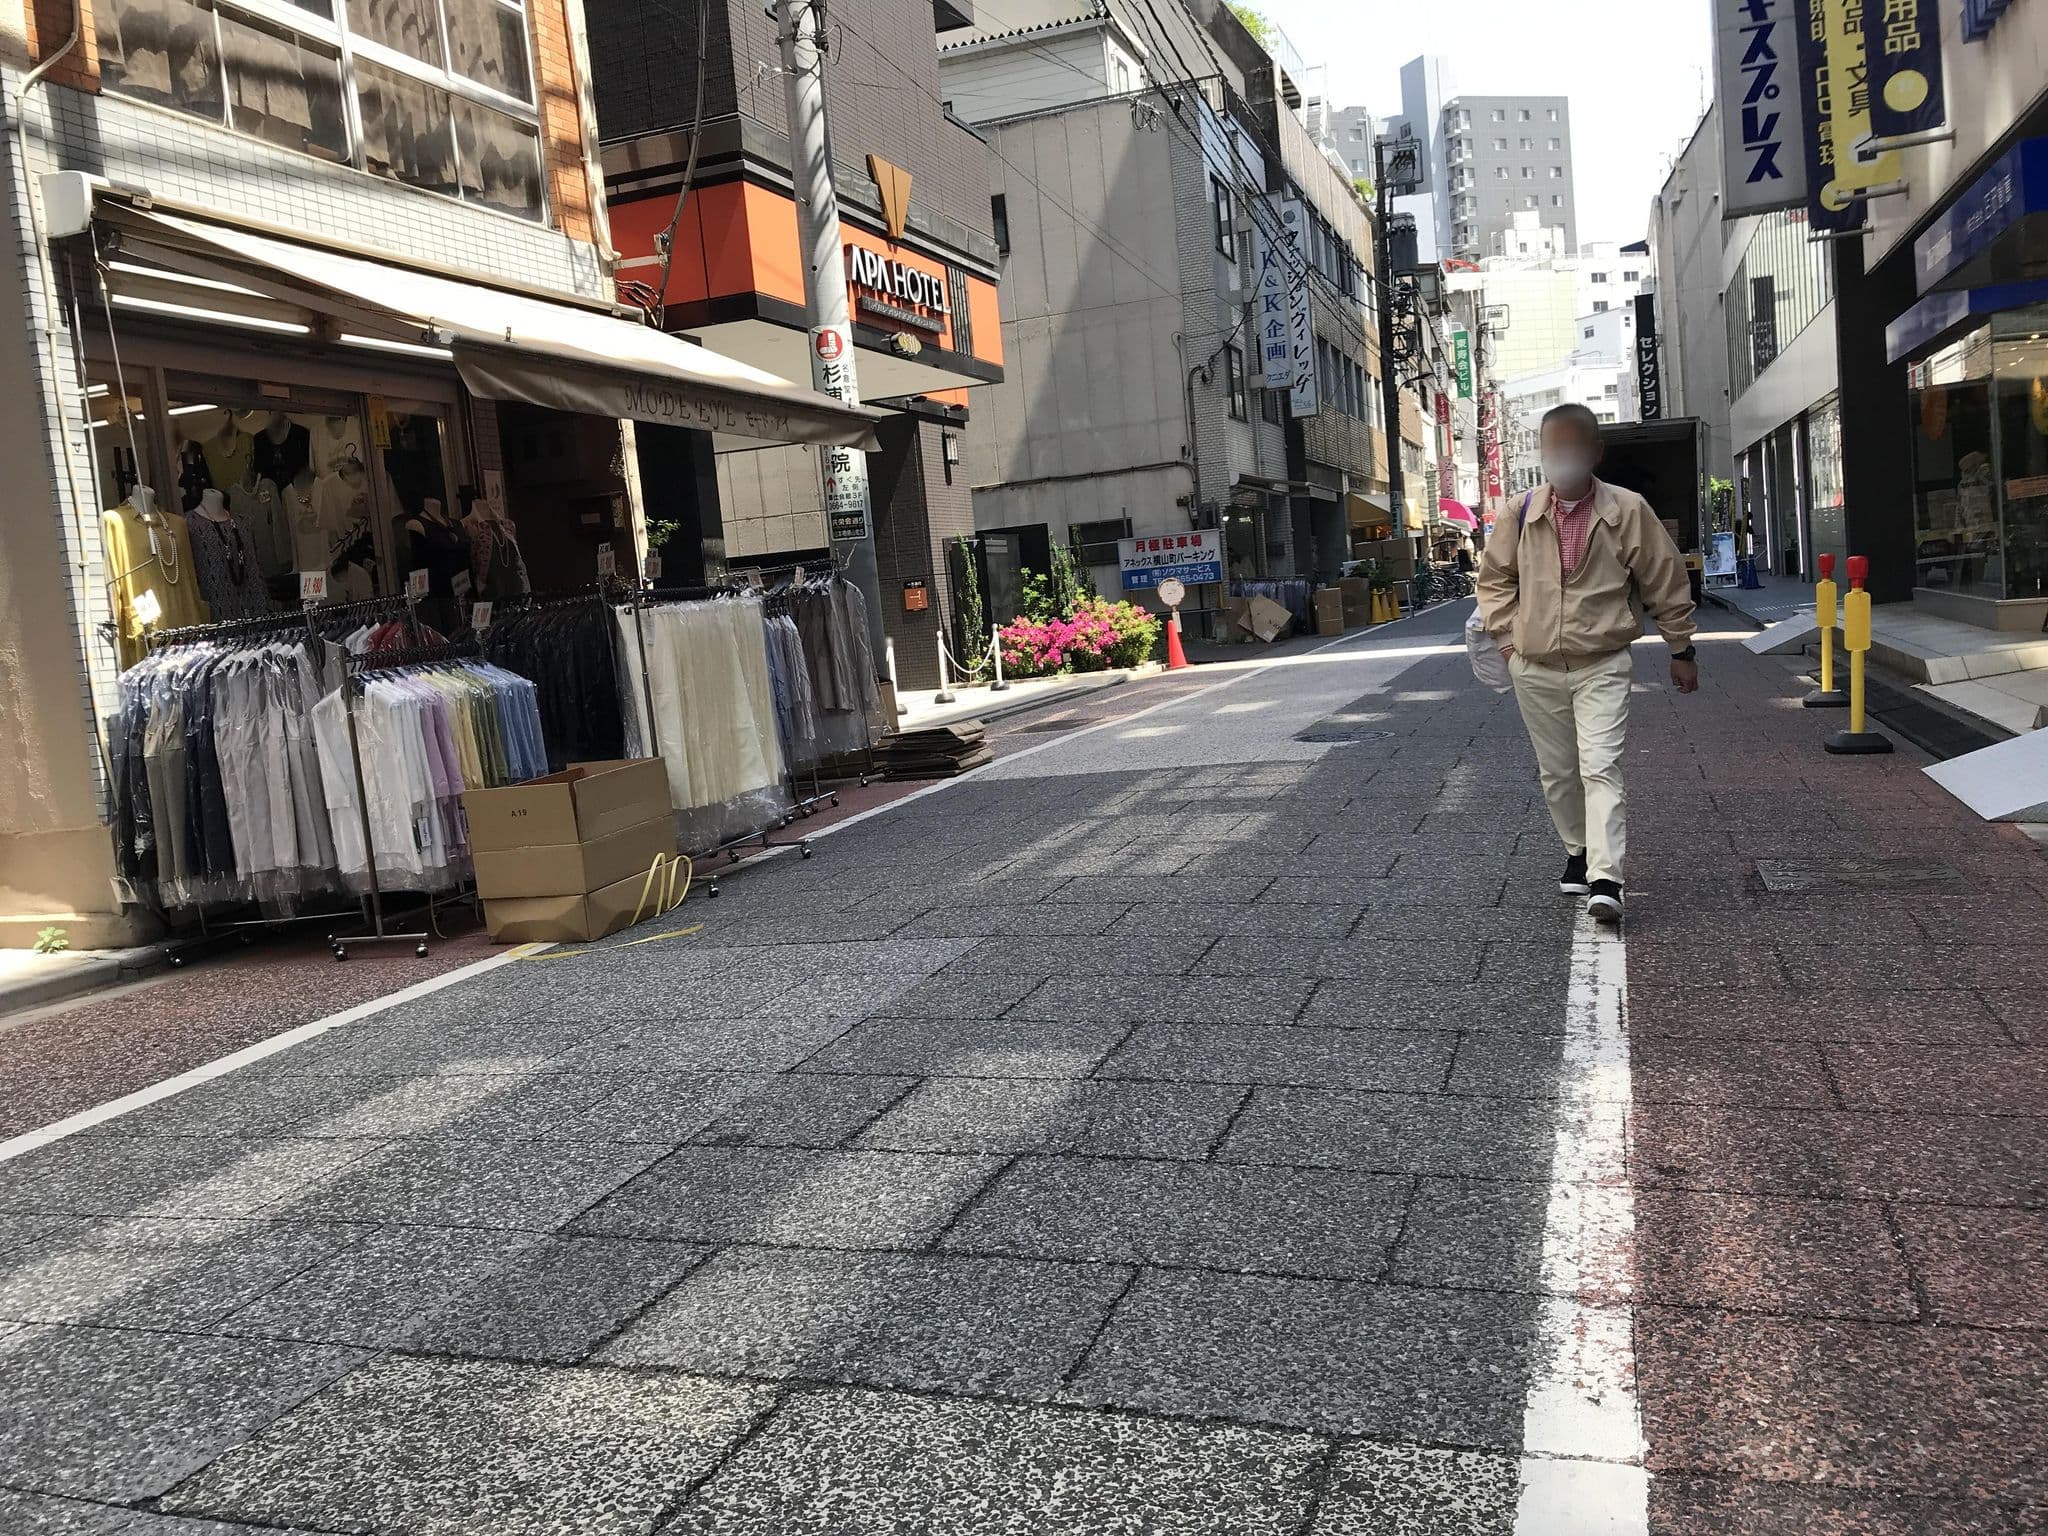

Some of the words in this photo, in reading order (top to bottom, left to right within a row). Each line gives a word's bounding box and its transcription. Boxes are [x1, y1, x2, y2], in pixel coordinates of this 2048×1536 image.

[851, 244, 892, 293] APA
[892, 260, 951, 314] HOTEL
[1640, 336, 1657, 416] セレクション
[624, 385, 691, 420] MODE
[694, 398, 736, 429] EYE
[1136, 534, 1202, 552] 月極駐車場
